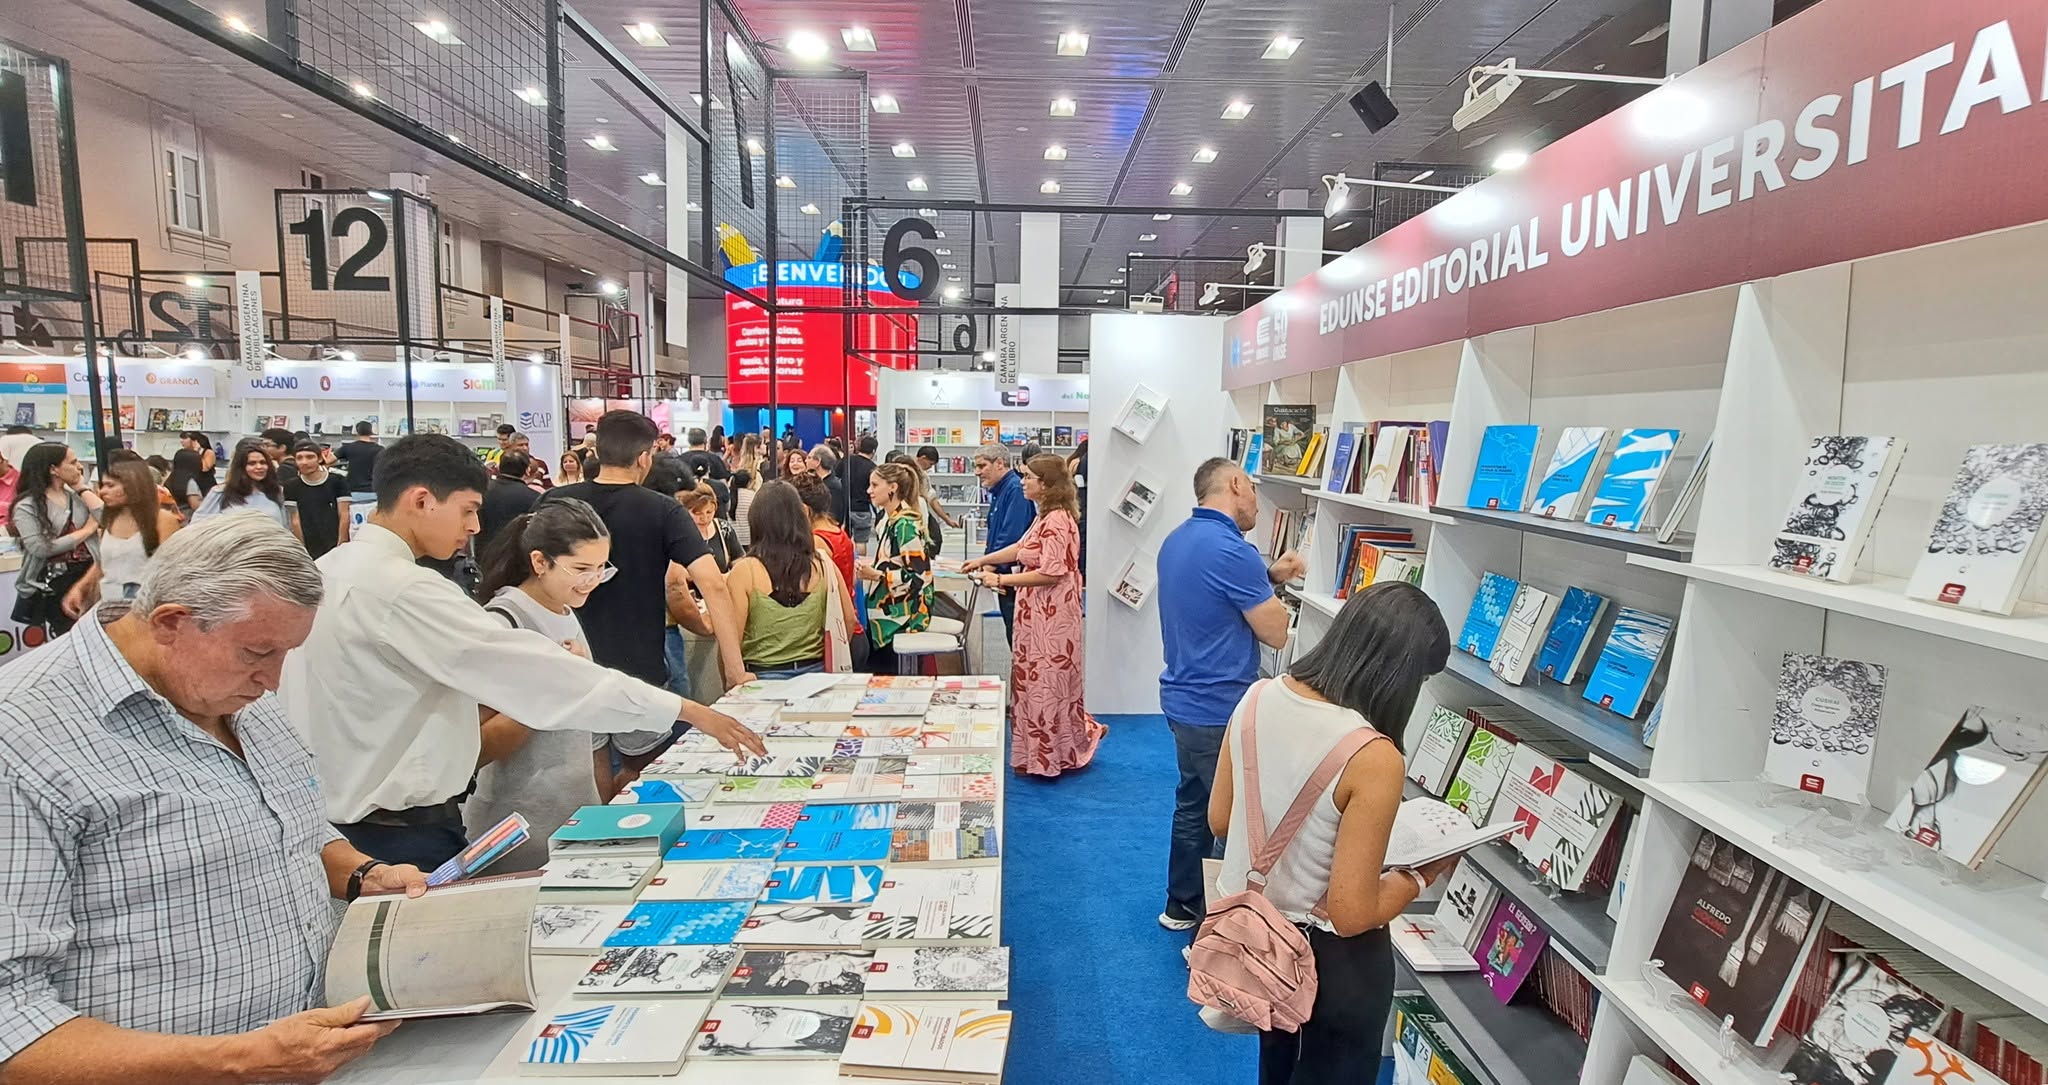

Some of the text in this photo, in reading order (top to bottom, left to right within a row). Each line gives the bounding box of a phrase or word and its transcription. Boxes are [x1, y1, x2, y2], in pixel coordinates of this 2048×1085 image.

[1319, 19, 2048, 336] EDUNSE EDITORIAL UNIVERSITA
[289, 207, 390, 292] 12
[882, 217, 940, 301] 6
[241, 282, 252, 332] ARGENTINA
[250, 290, 262, 372] DE PUBLICACIONES
[1000, 295, 1008, 345] ARGENNA
[159, 377, 200, 387] GRANICA
[1008, 340, 1016, 384] DEL LIBRO
[531, 411, 552, 428] CAP
[1508, 902, 1516, 914] EL
[1696, 898, 1732, 925] ALFREDO
